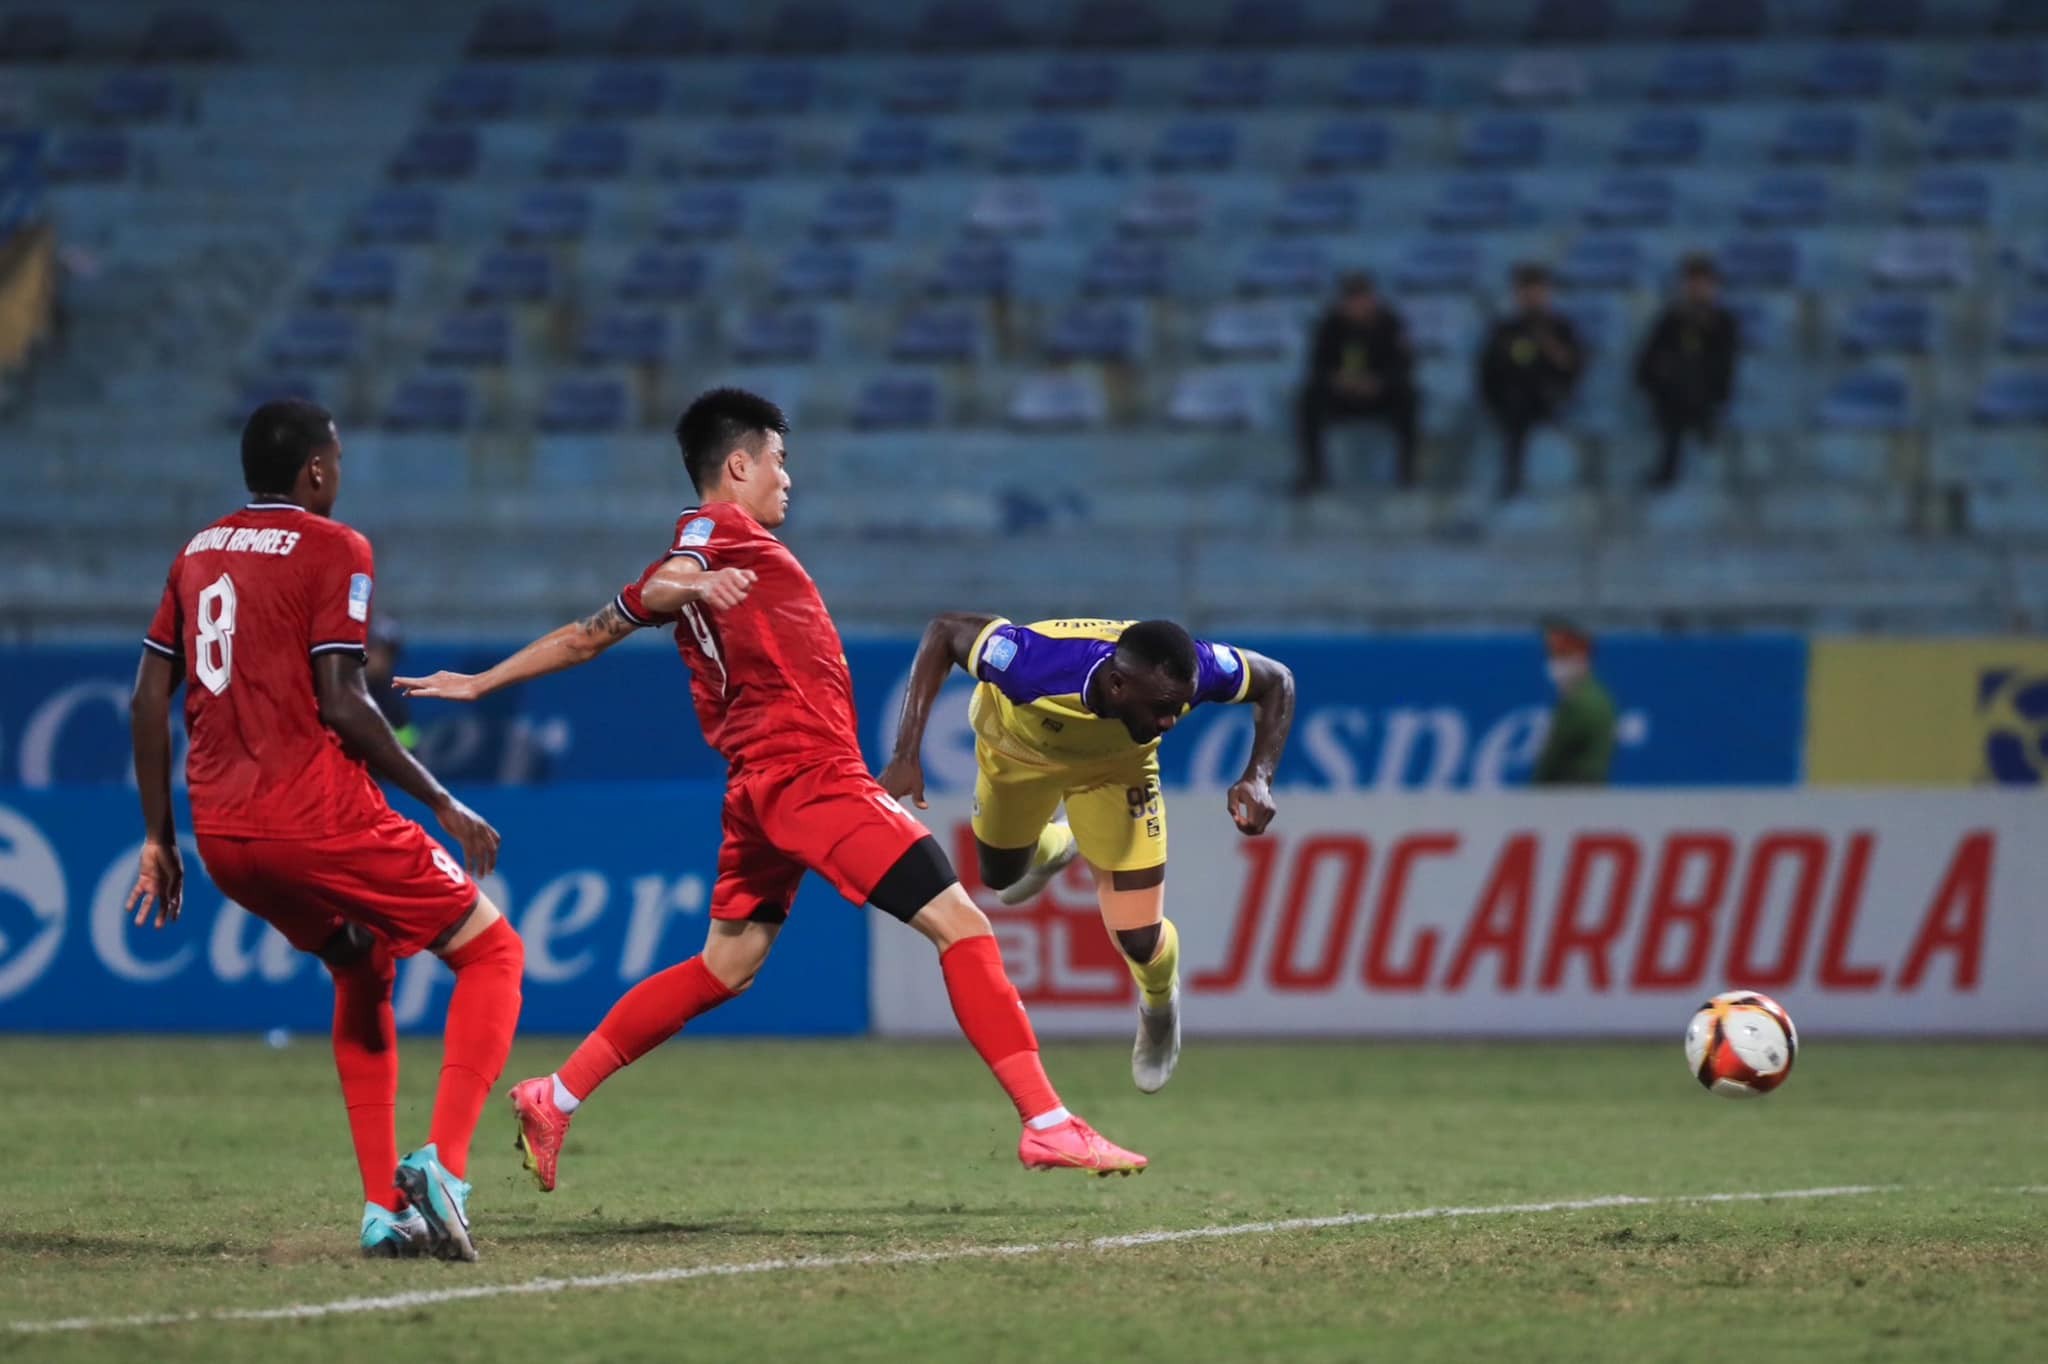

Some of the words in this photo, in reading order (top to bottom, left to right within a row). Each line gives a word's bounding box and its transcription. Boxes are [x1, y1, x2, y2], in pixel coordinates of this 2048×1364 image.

[226, 527, 301, 556] RAMIRES
[196, 572, 236, 697] 8
[430, 846, 465, 884] 8
[1189, 832, 1996, 992] JOGARBOLA
